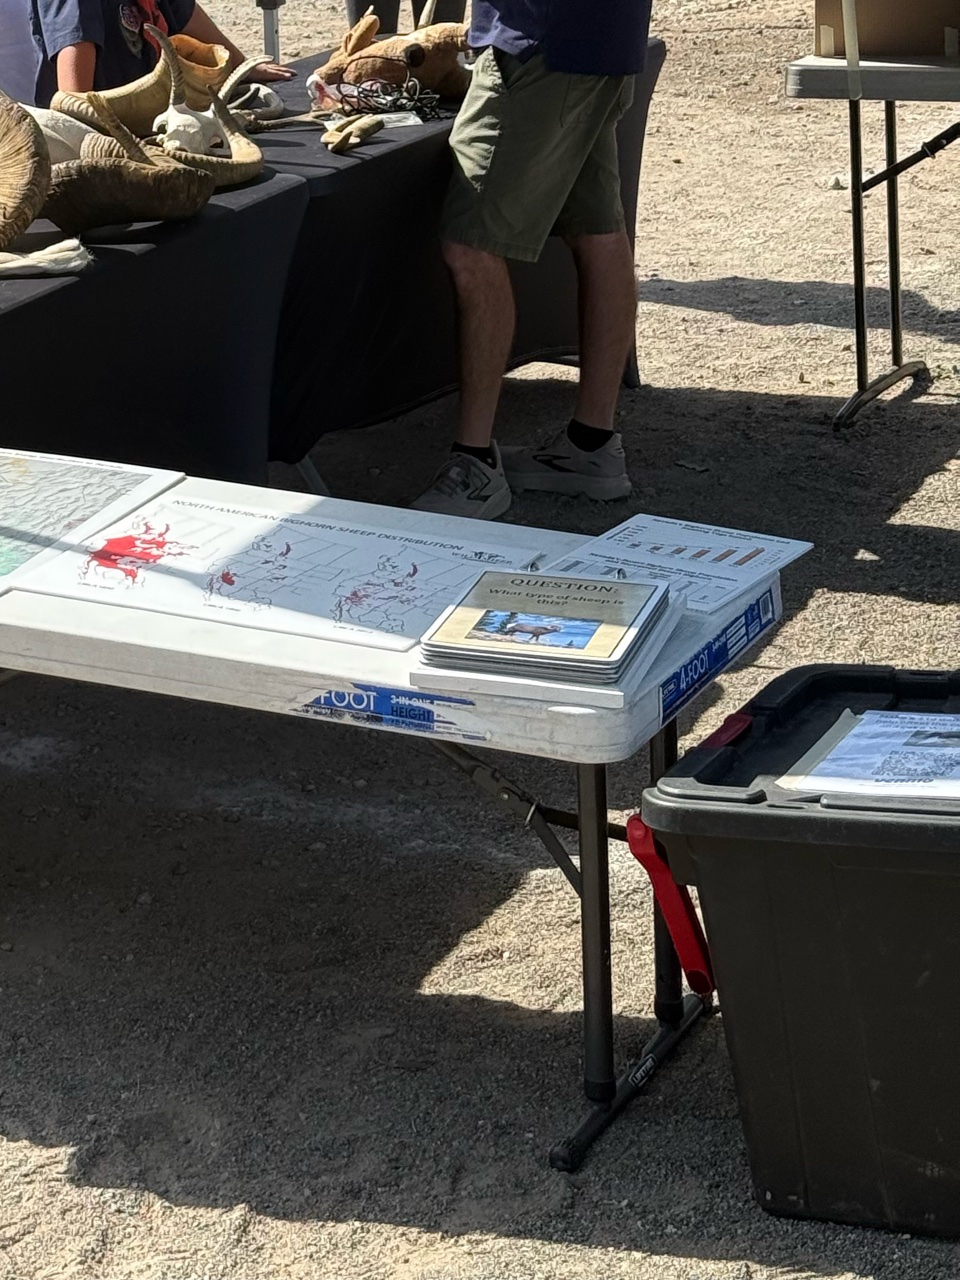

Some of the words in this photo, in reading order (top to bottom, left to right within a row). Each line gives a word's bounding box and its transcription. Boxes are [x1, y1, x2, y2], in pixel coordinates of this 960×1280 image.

[172, 499, 215, 511] NORTH
[216, 507, 280, 521] AMERICAN
[280, 517, 335, 531] BIGHORN
[339, 526, 377, 537] SHEEP
[377, 533, 464, 550] DISTRIBUTION
[510, 578, 619, 594] QUESTION:
[489, 588, 522, 597] What
[572, 596, 610, 605] sheep
[680, 649, 709, 690] 4-FOOT
[320, 690, 378, 711] FOOT
[390, 705, 433, 721] HEIGHT
